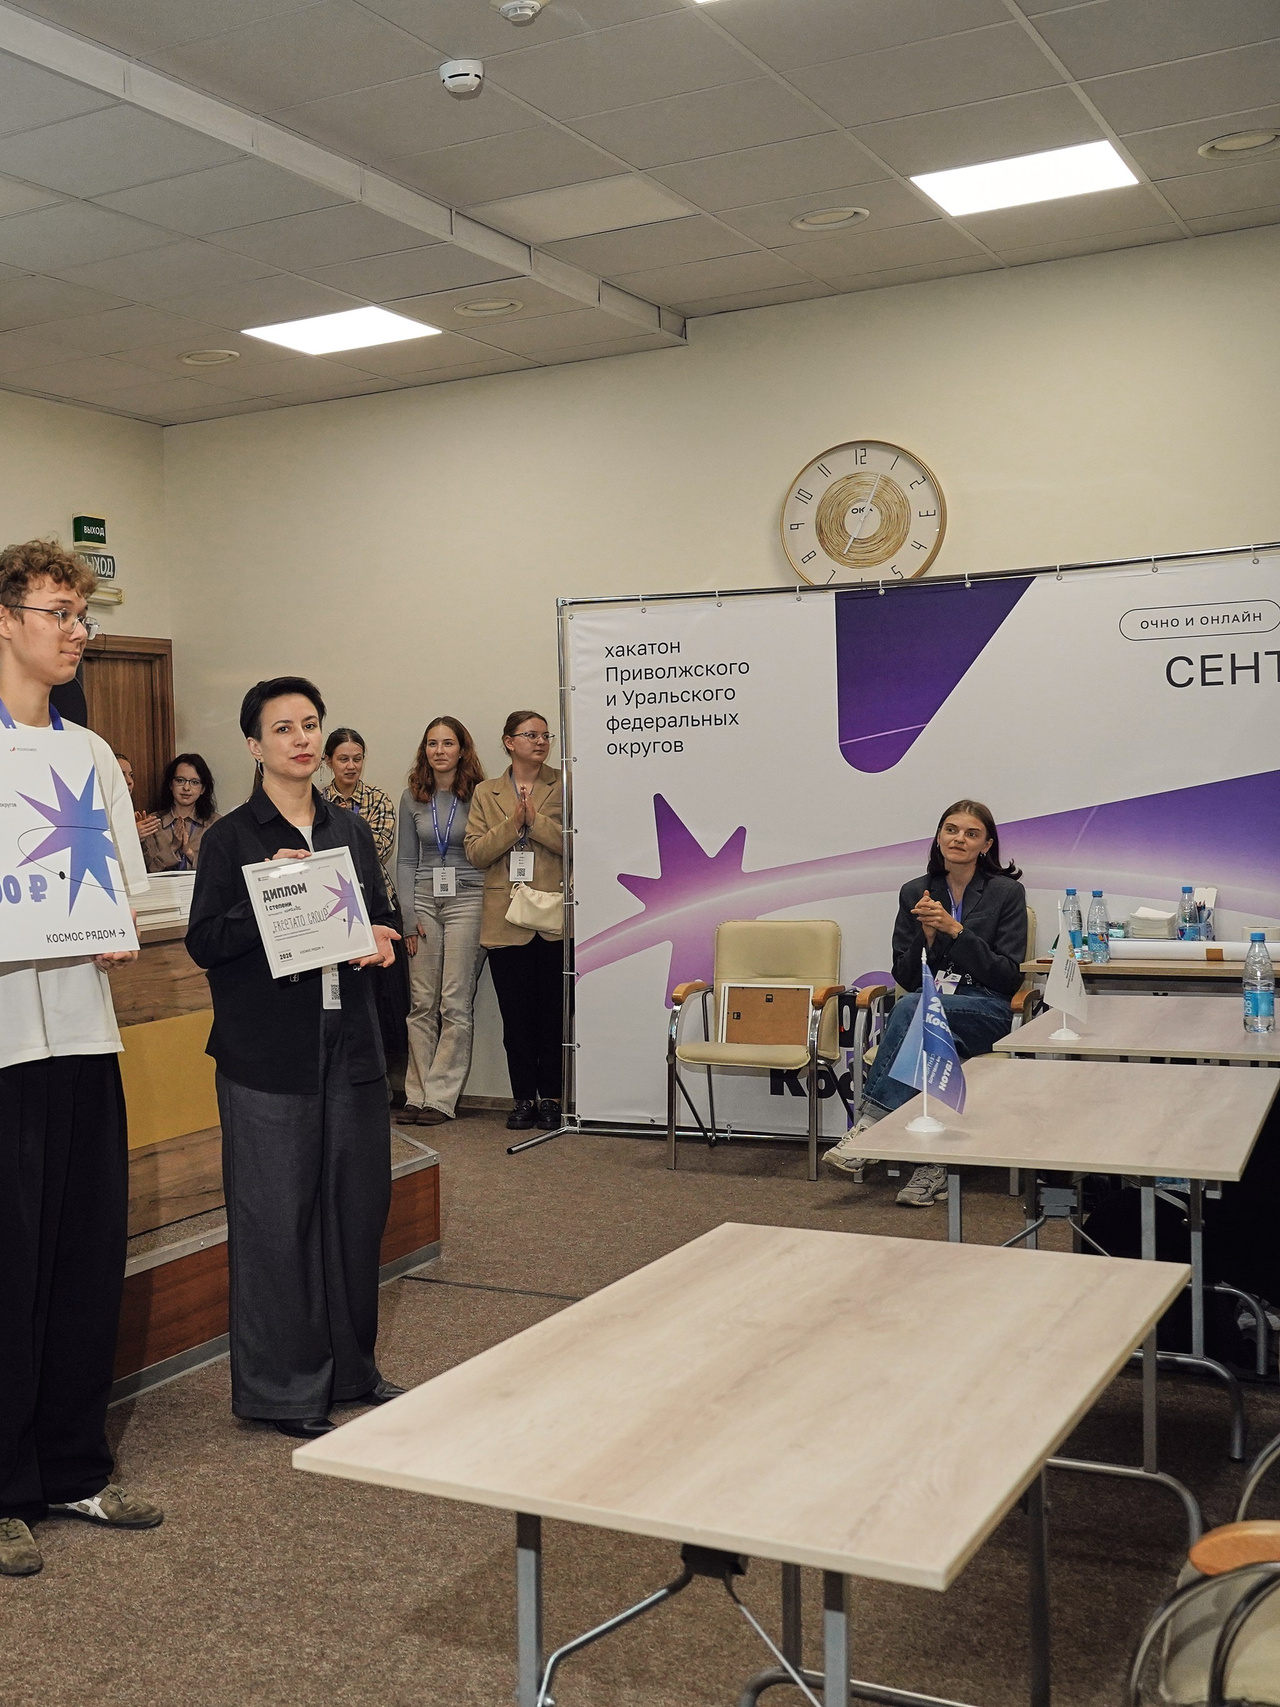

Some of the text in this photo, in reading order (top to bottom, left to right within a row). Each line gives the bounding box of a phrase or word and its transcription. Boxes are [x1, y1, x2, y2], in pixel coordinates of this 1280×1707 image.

[855, 448, 866, 465] 12
[818, 463, 832, 477] 11
[910, 476, 926, 489] 2
[795, 488, 813, 504] 10
[84, 526, 104, 536] ВЫХОД
[910, 540, 927, 550] 4
[802, 551, 816, 563] 8
[1140, 611, 1262, 630] ОЧНО И ОНЛАЙН
[604, 642, 680, 658] хакатон
[606, 662, 750, 685] Приволжского
[606, 688, 736, 708] и Уральского
[606, 713, 739, 734] федеральных
[606, 740, 684, 758] округов
[262, 882, 307, 903] ДИПЛОМ
[269, 902, 292, 910] степени
[46, 929, 116, 944] КОСМОС РЯДОМ
